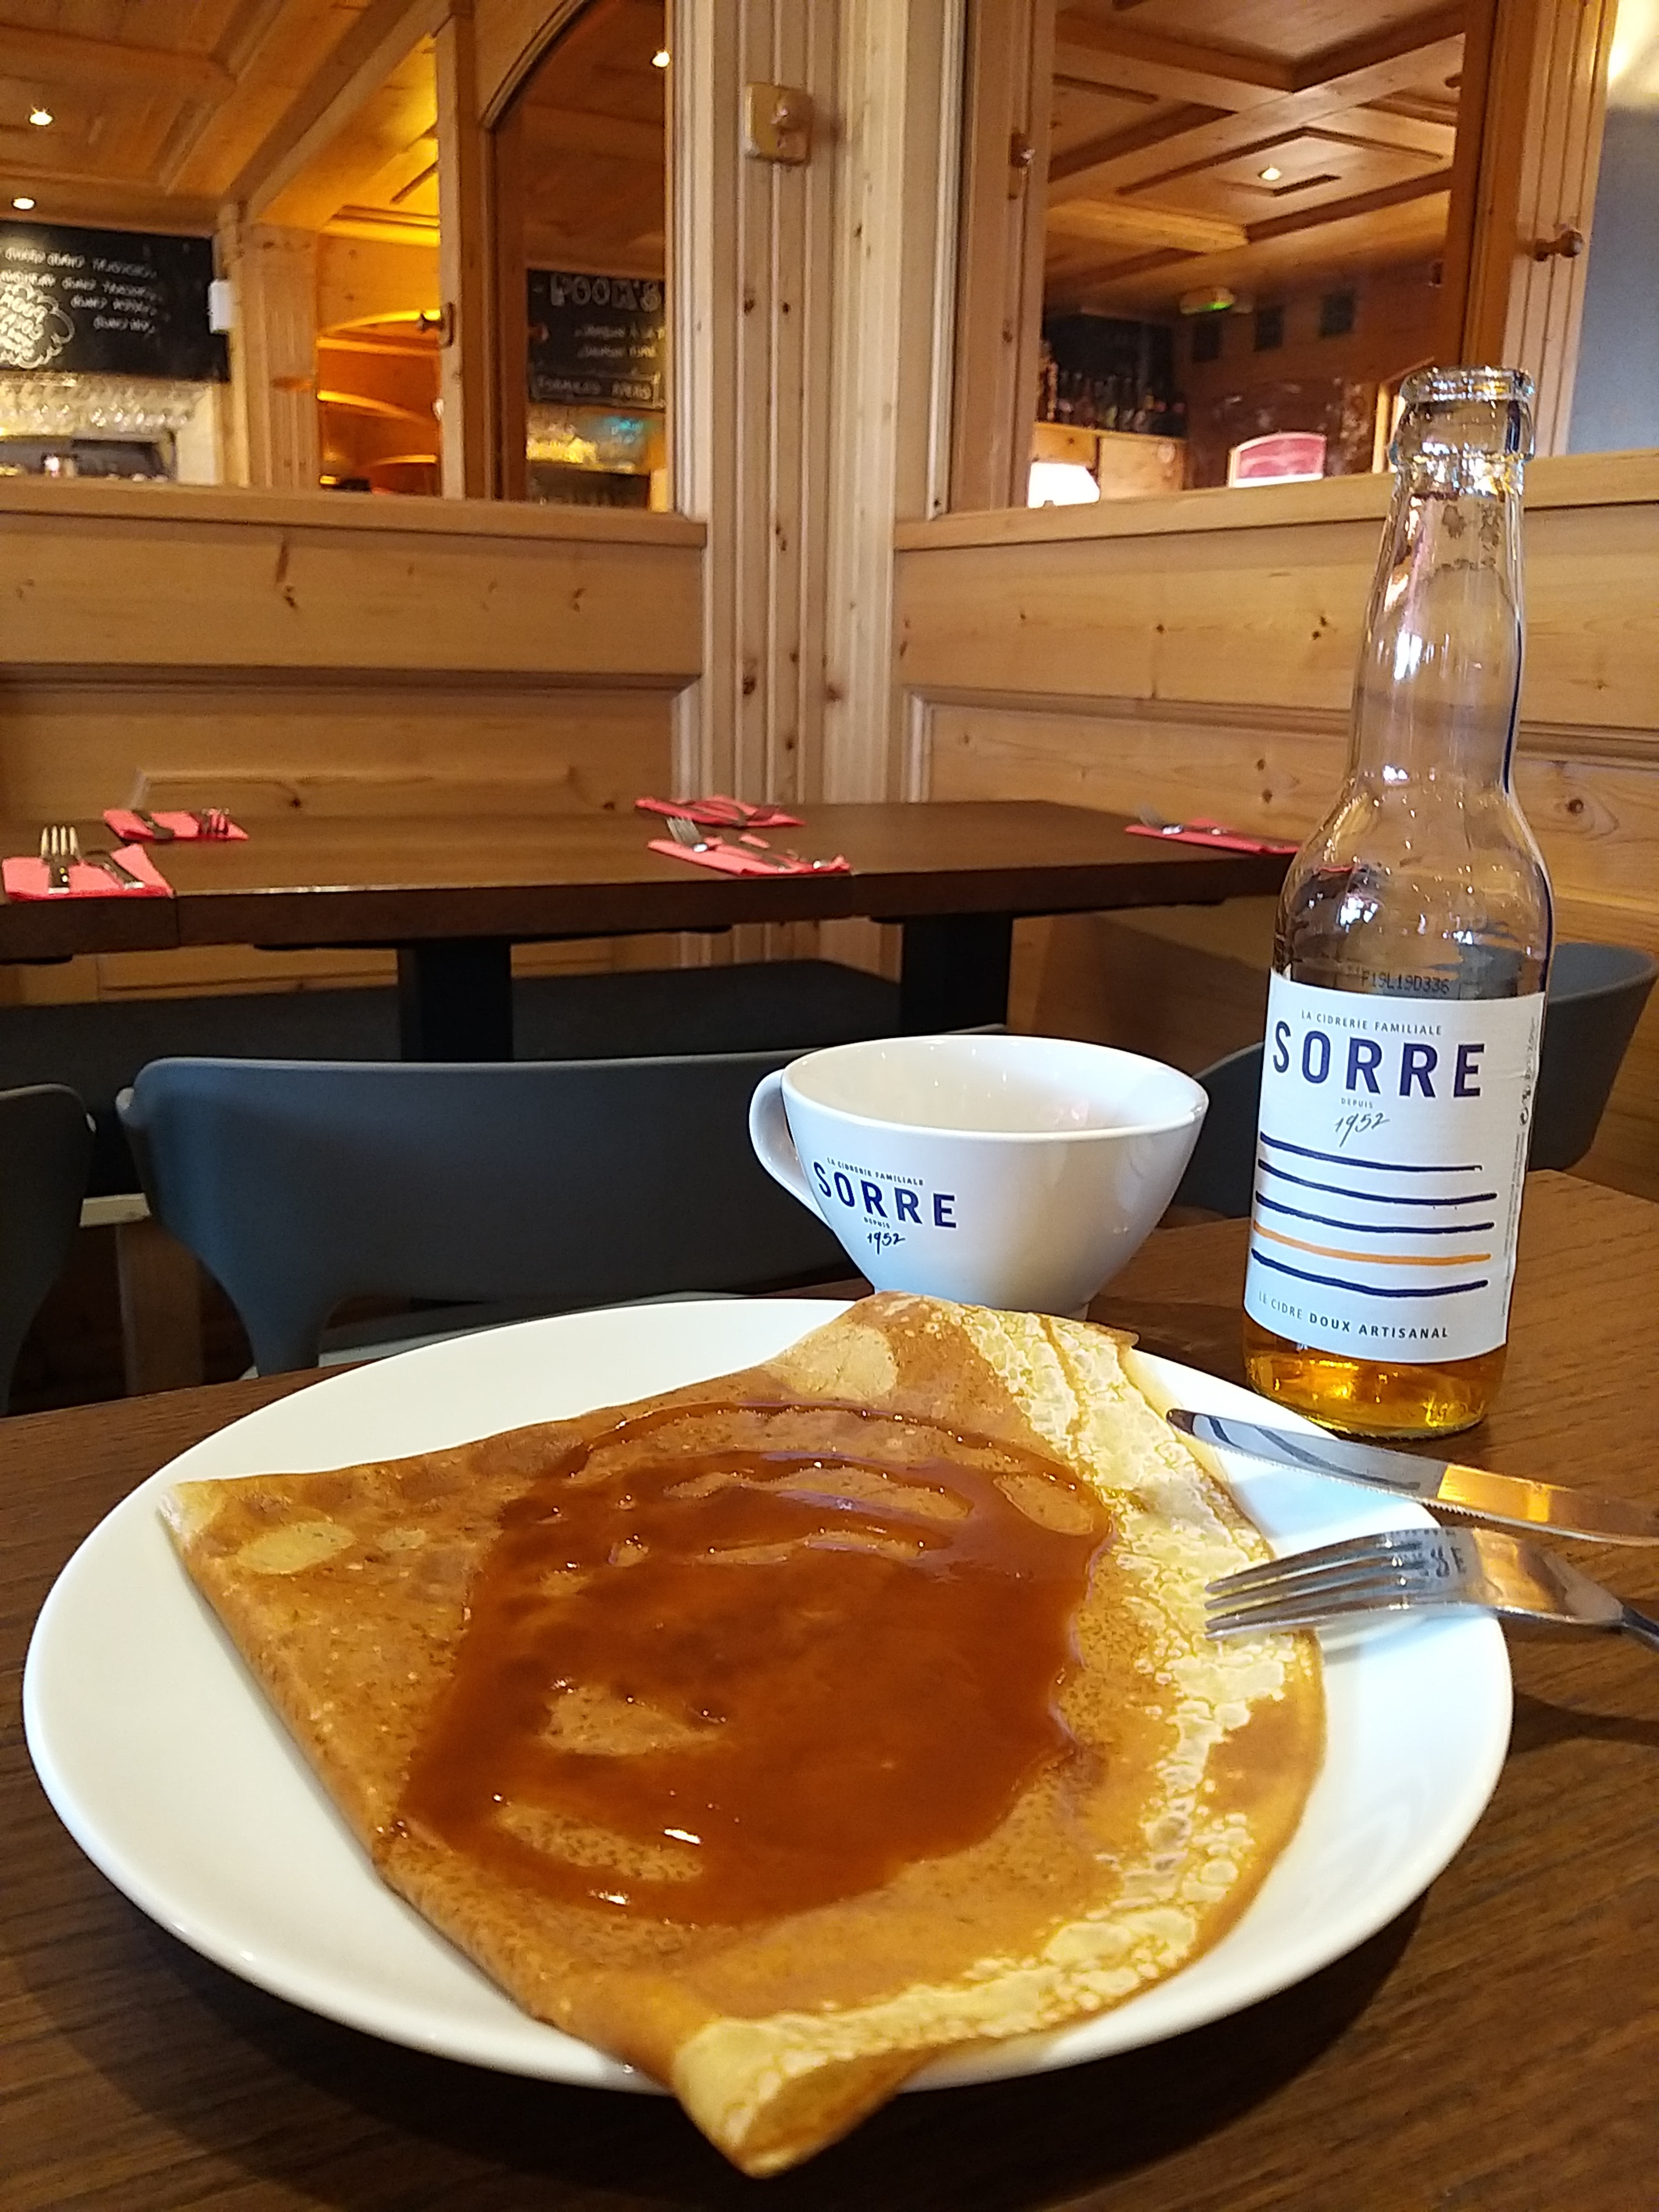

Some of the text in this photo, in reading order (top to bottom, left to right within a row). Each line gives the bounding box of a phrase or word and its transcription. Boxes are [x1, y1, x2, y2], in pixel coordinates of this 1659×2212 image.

[1301, 1010, 1442, 1035] LA CIDRERIE FAMILIALE
[1273, 1021, 1485, 1098] SORRE
[1341, 1097, 1373, 1108] DEPUIS
[1334, 1113, 1390, 1147] 1952
[827, 1157, 923, 1186] LA CIDRERIE FAMILIALE
[813, 1161, 956, 1228] SORRE
[864, 1217, 890, 1229] DEPUIS
[867, 1231, 906, 1254] 1952
[1259, 1291, 1448, 1339] LE CIDRE DOUX ARTISANAL
